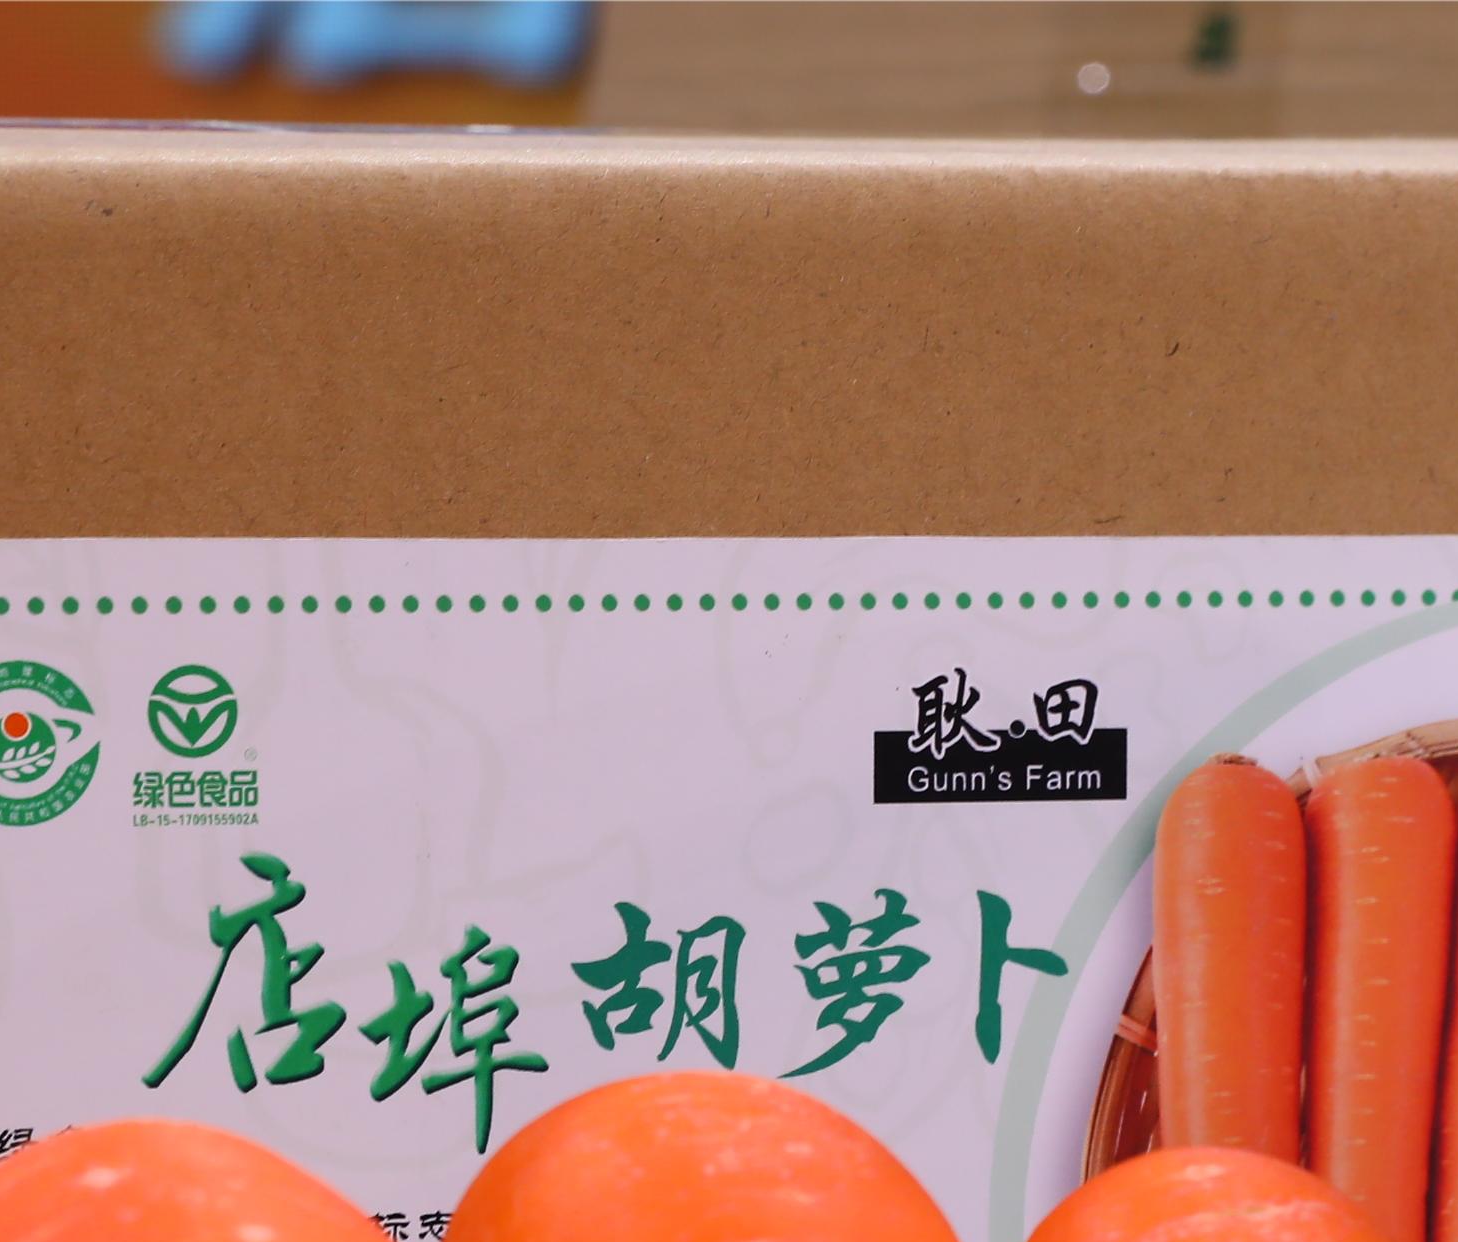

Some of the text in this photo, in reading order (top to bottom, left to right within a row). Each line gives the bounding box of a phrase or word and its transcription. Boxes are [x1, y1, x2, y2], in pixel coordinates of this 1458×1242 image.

[133, 770, 258, 808] 绿色食品
[907, 764, 1102, 792] Gunn's Farm
[141, 851, 1070, 1155] 店埠胡萝卜
